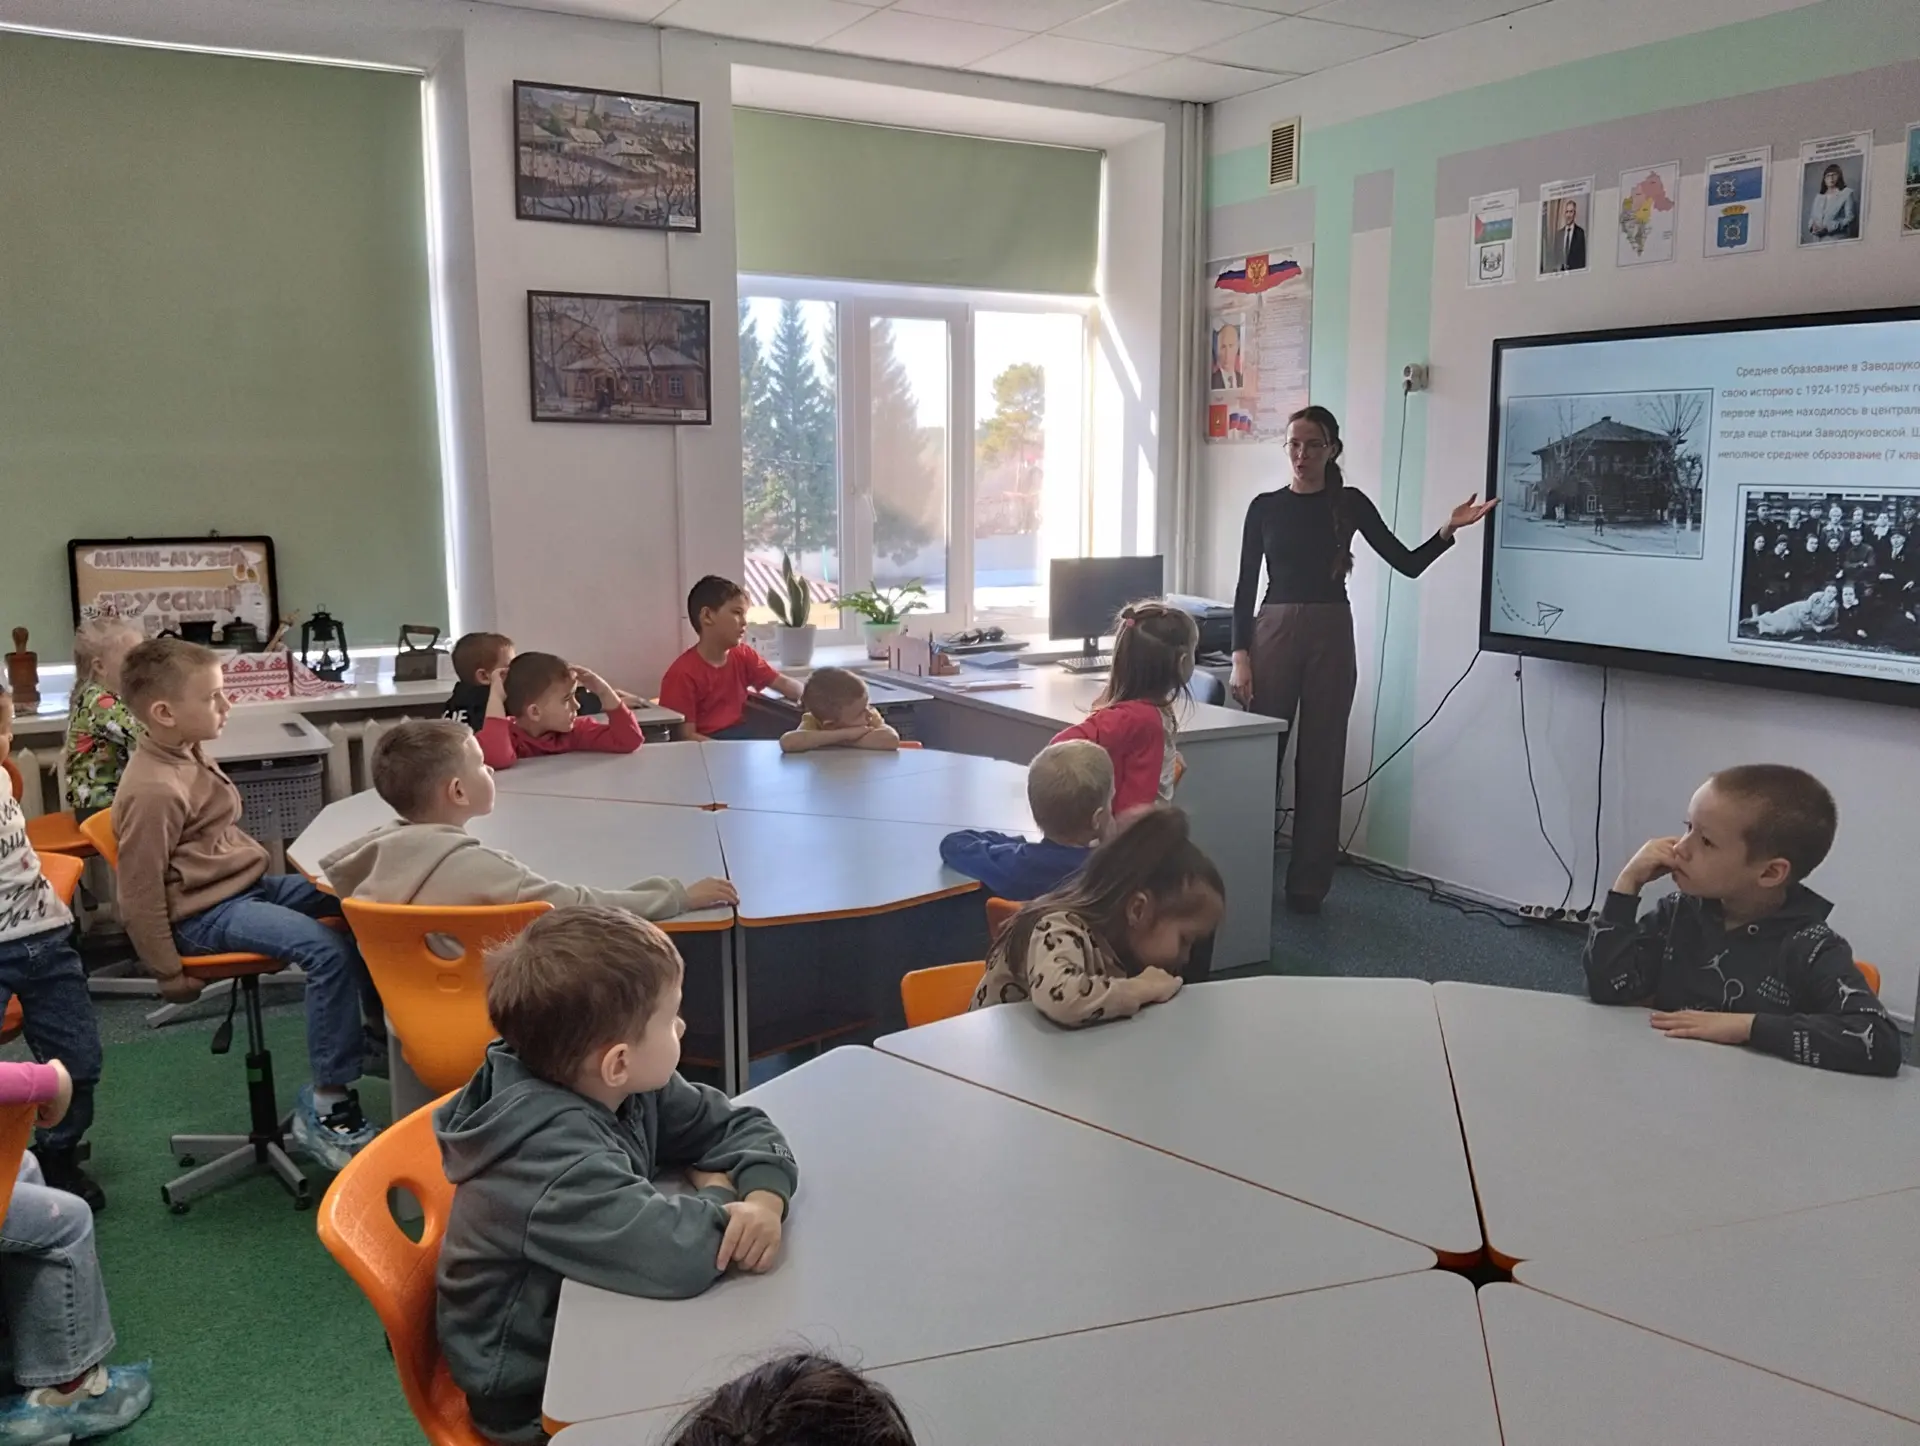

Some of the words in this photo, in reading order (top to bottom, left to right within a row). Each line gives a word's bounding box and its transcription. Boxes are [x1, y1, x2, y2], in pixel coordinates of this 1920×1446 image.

[1736, 366, 1779, 378] Среднее
[1781, 363, 1849, 375] образование
[1851, 364, 1858, 372] в
[1860, 360, 1920, 373] Заводоуко
[1721, 390, 1748, 398] свою
[1750, 387, 1794, 399] историю
[1796, 387, 1802, 396] с
[1805, 384, 1860, 396] 1924-1925
[1862, 382, 1910, 396] учебных
[1720, 408, 1756, 420] первое
[1758, 408, 1794, 419] здание
[1796, 405, 1859, 417] находилось
[1861, 407, 1869, 416] в
[1719, 429, 1746, 440] тогда
[1747, 430, 1768, 438] еще
[1770, 428, 1813, 439] станции
[1718, 450, 1764, 460] неполное
[1766, 450, 1810, 461] среднее
[1812, 447, 1882, 460] образование
[1885, 448, 1896, 462] (7
